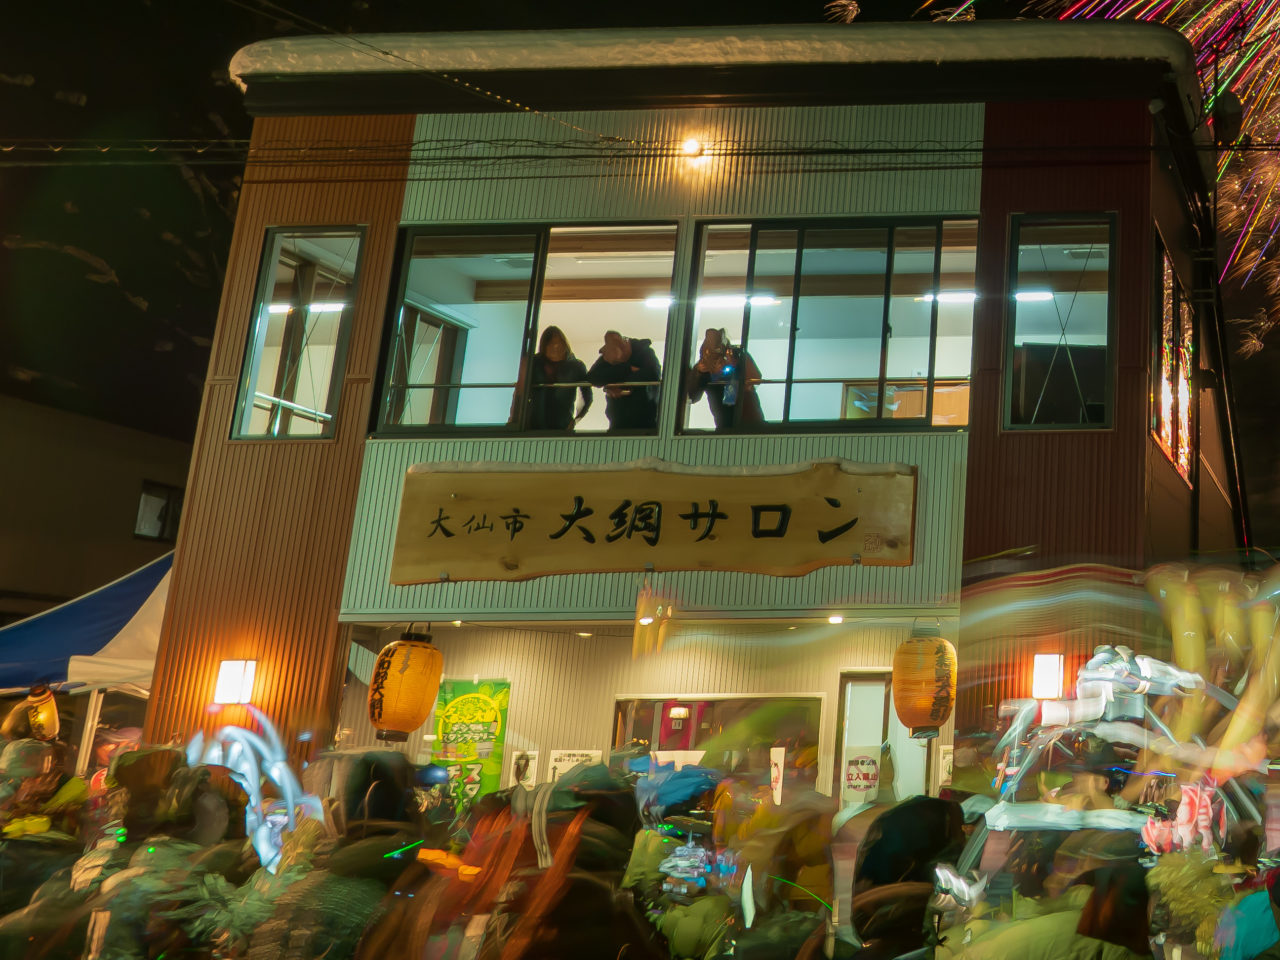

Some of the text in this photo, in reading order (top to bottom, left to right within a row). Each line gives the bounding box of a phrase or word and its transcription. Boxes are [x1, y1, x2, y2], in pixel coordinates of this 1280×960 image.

[427, 507, 531, 542] 大仙市
[549, 496, 859, 547] 大綱サロン
[847, 773, 878, 781] 立入禁止
